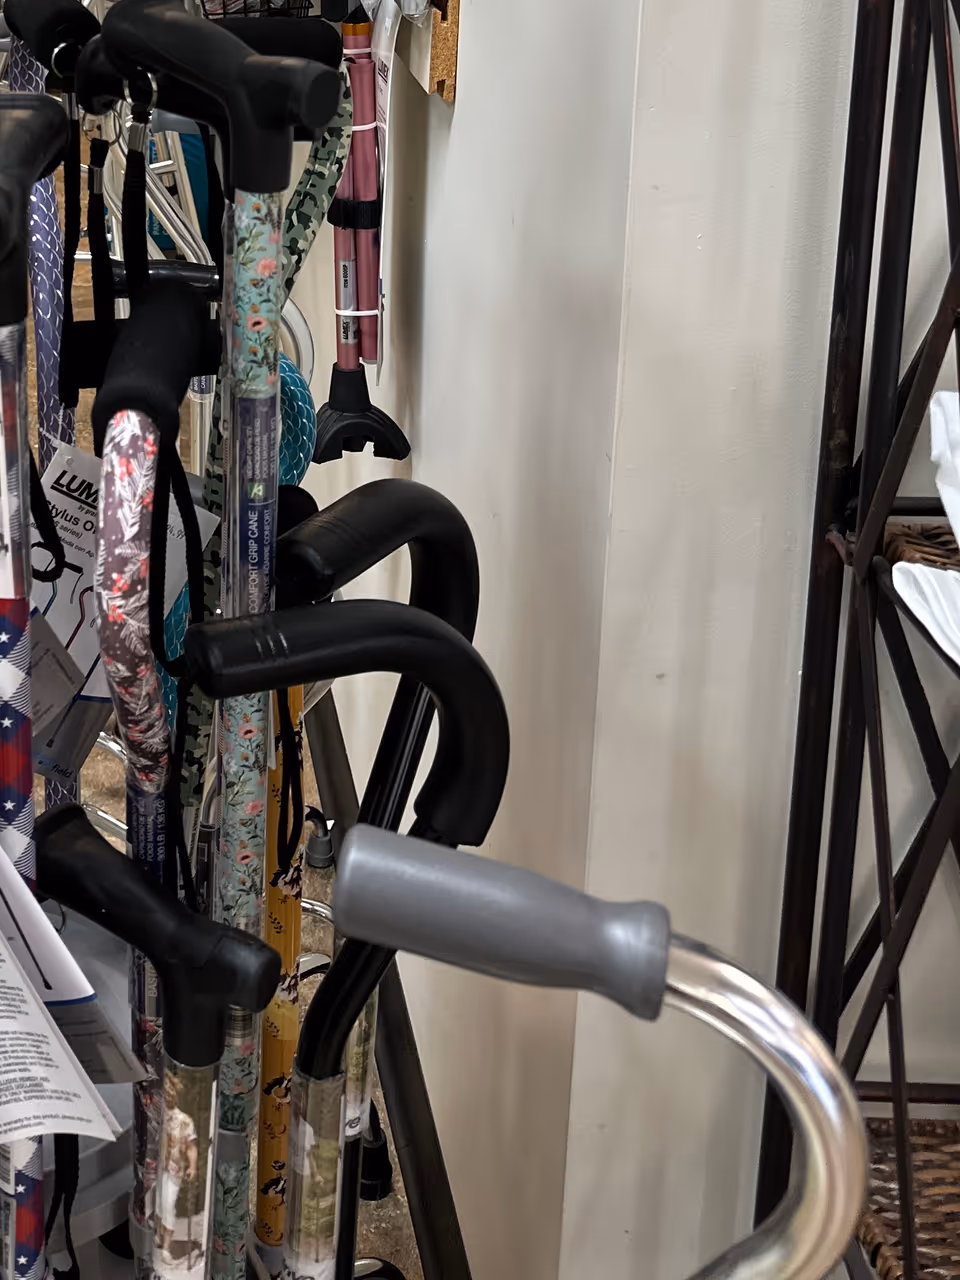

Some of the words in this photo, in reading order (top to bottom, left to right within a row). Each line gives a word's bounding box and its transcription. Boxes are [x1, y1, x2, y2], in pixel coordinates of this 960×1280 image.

[248, 510, 258, 539] CANE
[248, 540, 258, 564] GRIP
[248, 566, 258, 614] COMFORT
[157, 834, 165, 846] LB
